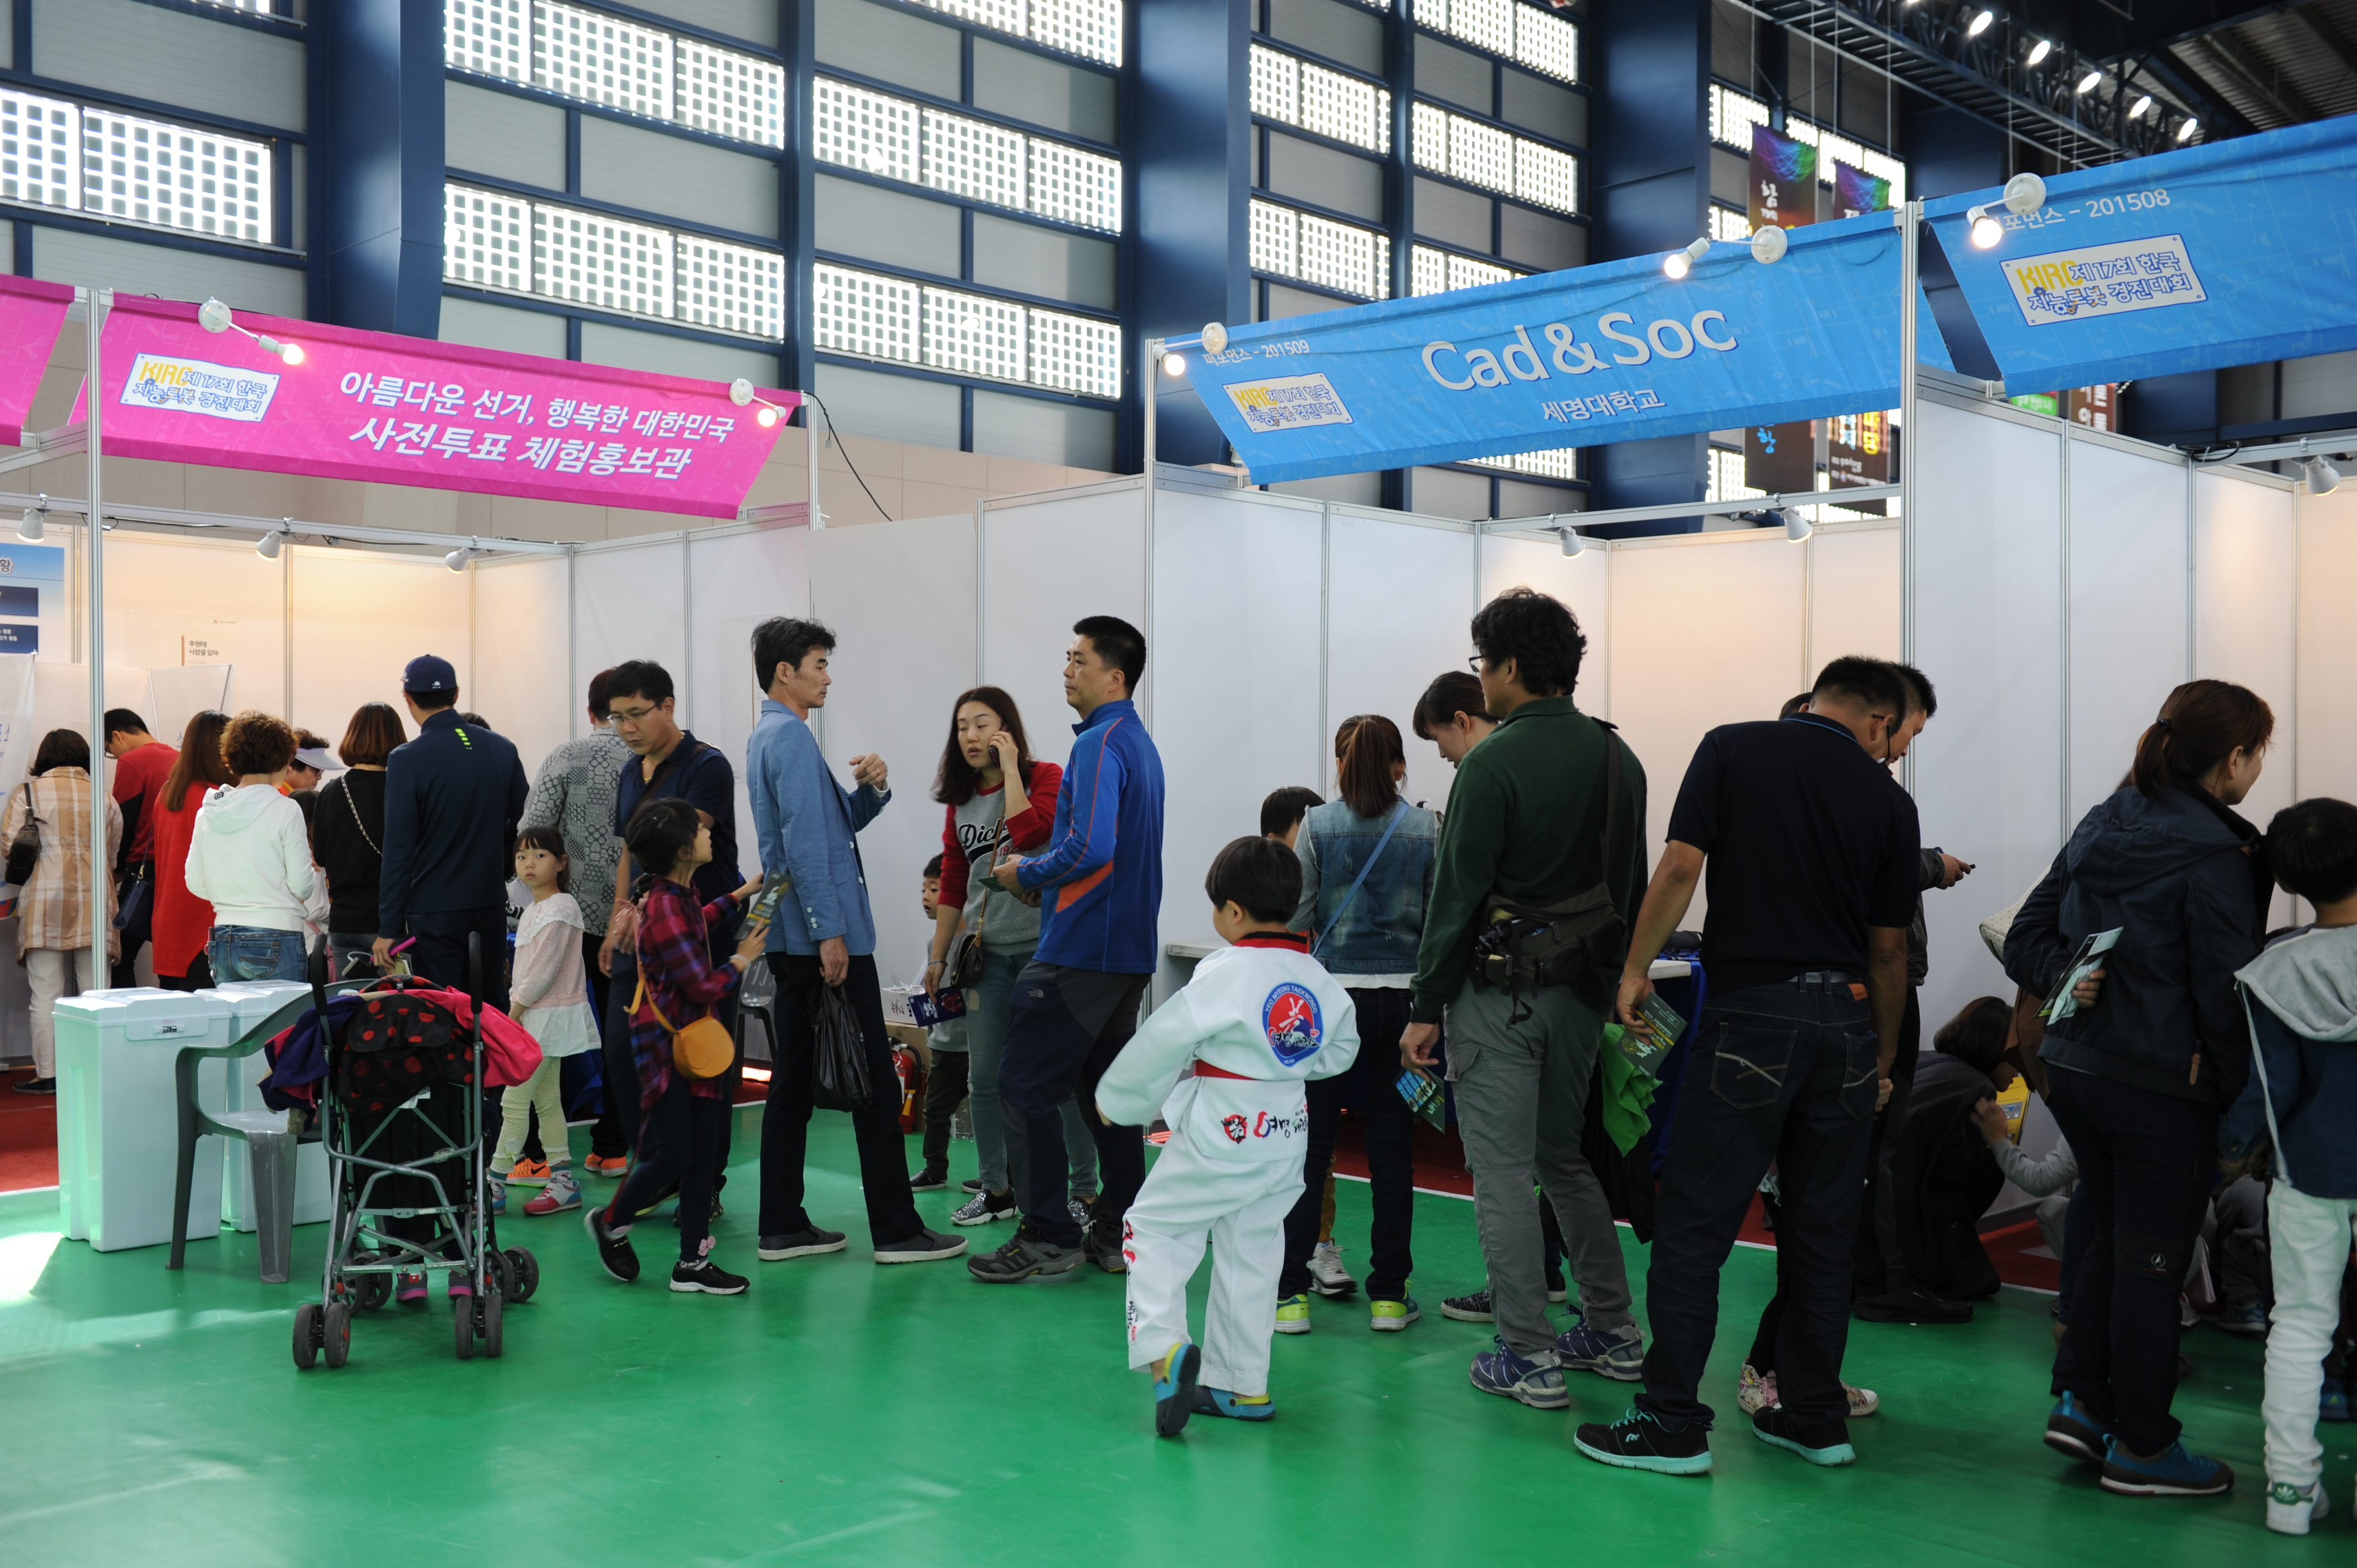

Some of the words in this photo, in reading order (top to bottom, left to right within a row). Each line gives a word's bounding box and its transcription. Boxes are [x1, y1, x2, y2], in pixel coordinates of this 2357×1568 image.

[2085, 188, 2171, 218] 201508
[2016, 259, 2085, 294] KIRC
[2069, 256, 2138, 282] 제17회
[2135, 251, 2181, 275] 한국
[2026, 285, 2108, 316] 지능로봇
[2107, 273, 2193, 303] 경진대회
[1202, 348, 1253, 366] 퍼포먼스
[1260, 339, 1310, 358] 201509
[139, 361, 193, 386] KIRC
[182, 371, 234, 393] 제17회
[236, 379, 267, 399] 한국
[132, 382, 195, 406] 지능로봇
[199, 391, 262, 413] 경진대회
[339, 372, 466, 415] 아름다운
[472, 388, 534, 426] 선거,
[547, 397, 629, 434] 행복한
[631, 409, 735, 443] 대한민국
[1233, 386, 1277, 410] KIRC
[1265, 386, 1307, 404] 제17회
[1303, 384, 1332, 401] 한국
[1541, 388, 1667, 424] 세명대학교
[1247, 405, 1296, 427] 지능로봇
[1293, 401, 1342, 420] 경진대회
[349, 416, 513, 462] 사전투표
[516, 436, 692, 481] 체험홍보관
[958, 818, 1008, 850] Dick
[1265, 999, 1274, 1013] YEO
[1272, 984, 1290, 1000] MYEONG
[1291, 985, 1318, 1014] TAEKWONDO
